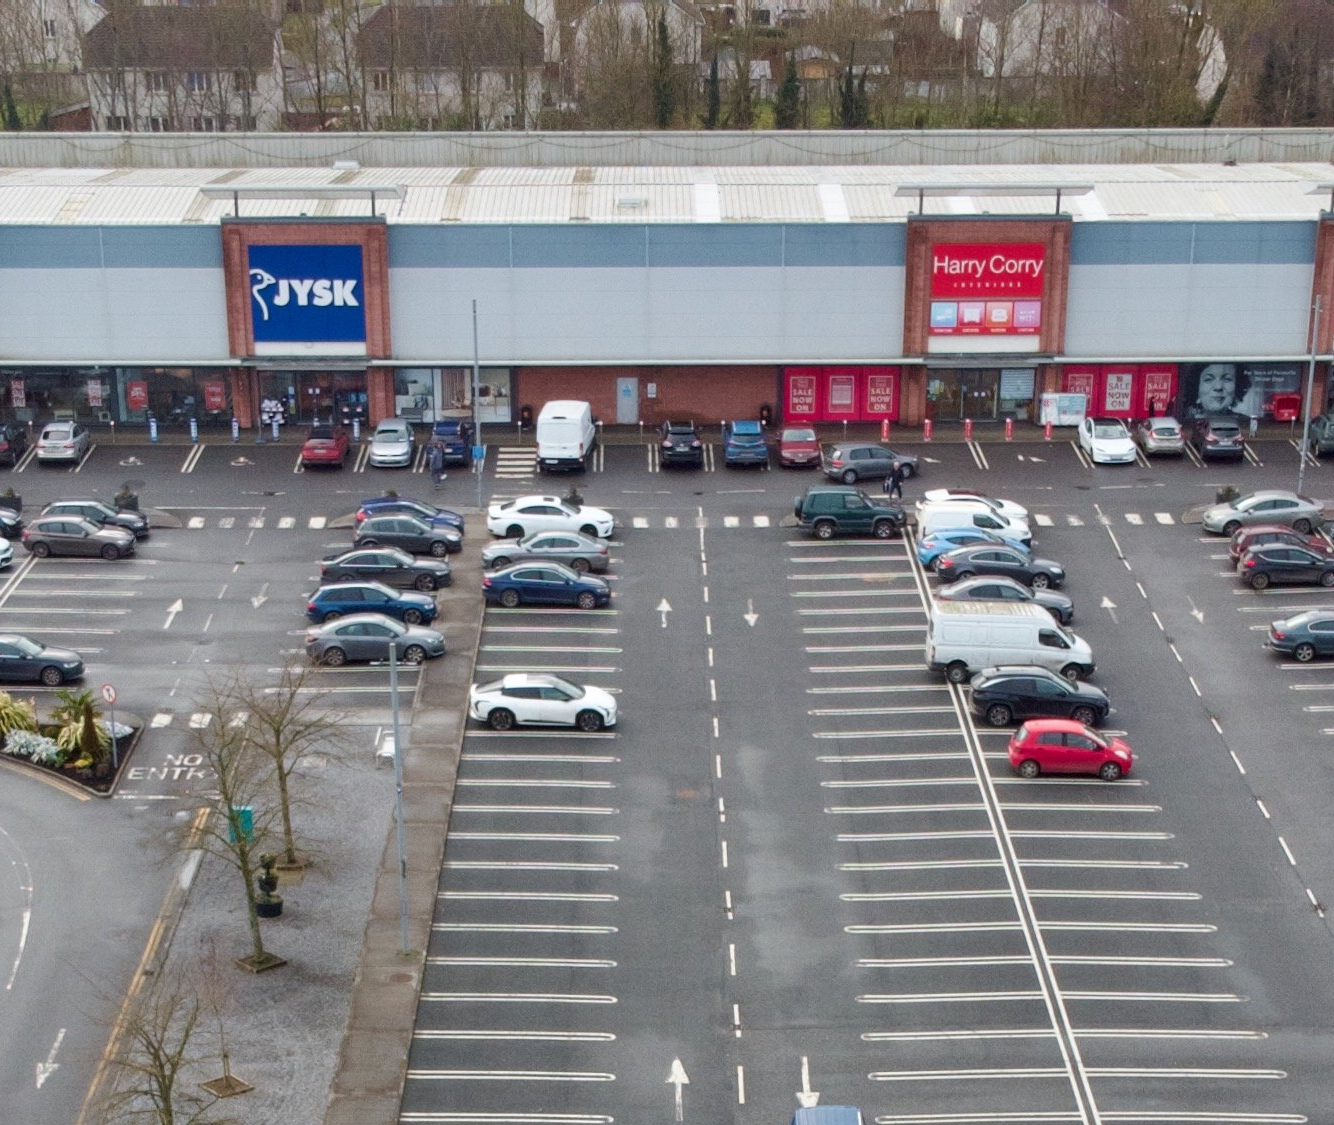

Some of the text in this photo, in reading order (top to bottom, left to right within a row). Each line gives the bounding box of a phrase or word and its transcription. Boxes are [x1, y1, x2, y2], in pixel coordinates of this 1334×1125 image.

[933, 255, 1044, 278] Harry Corry
[273, 279, 359, 306] JYSK
[1108, 383, 1129, 391] SALE
[1108, 392, 1130, 400] NOW
[163, 753, 203, 766] NO
